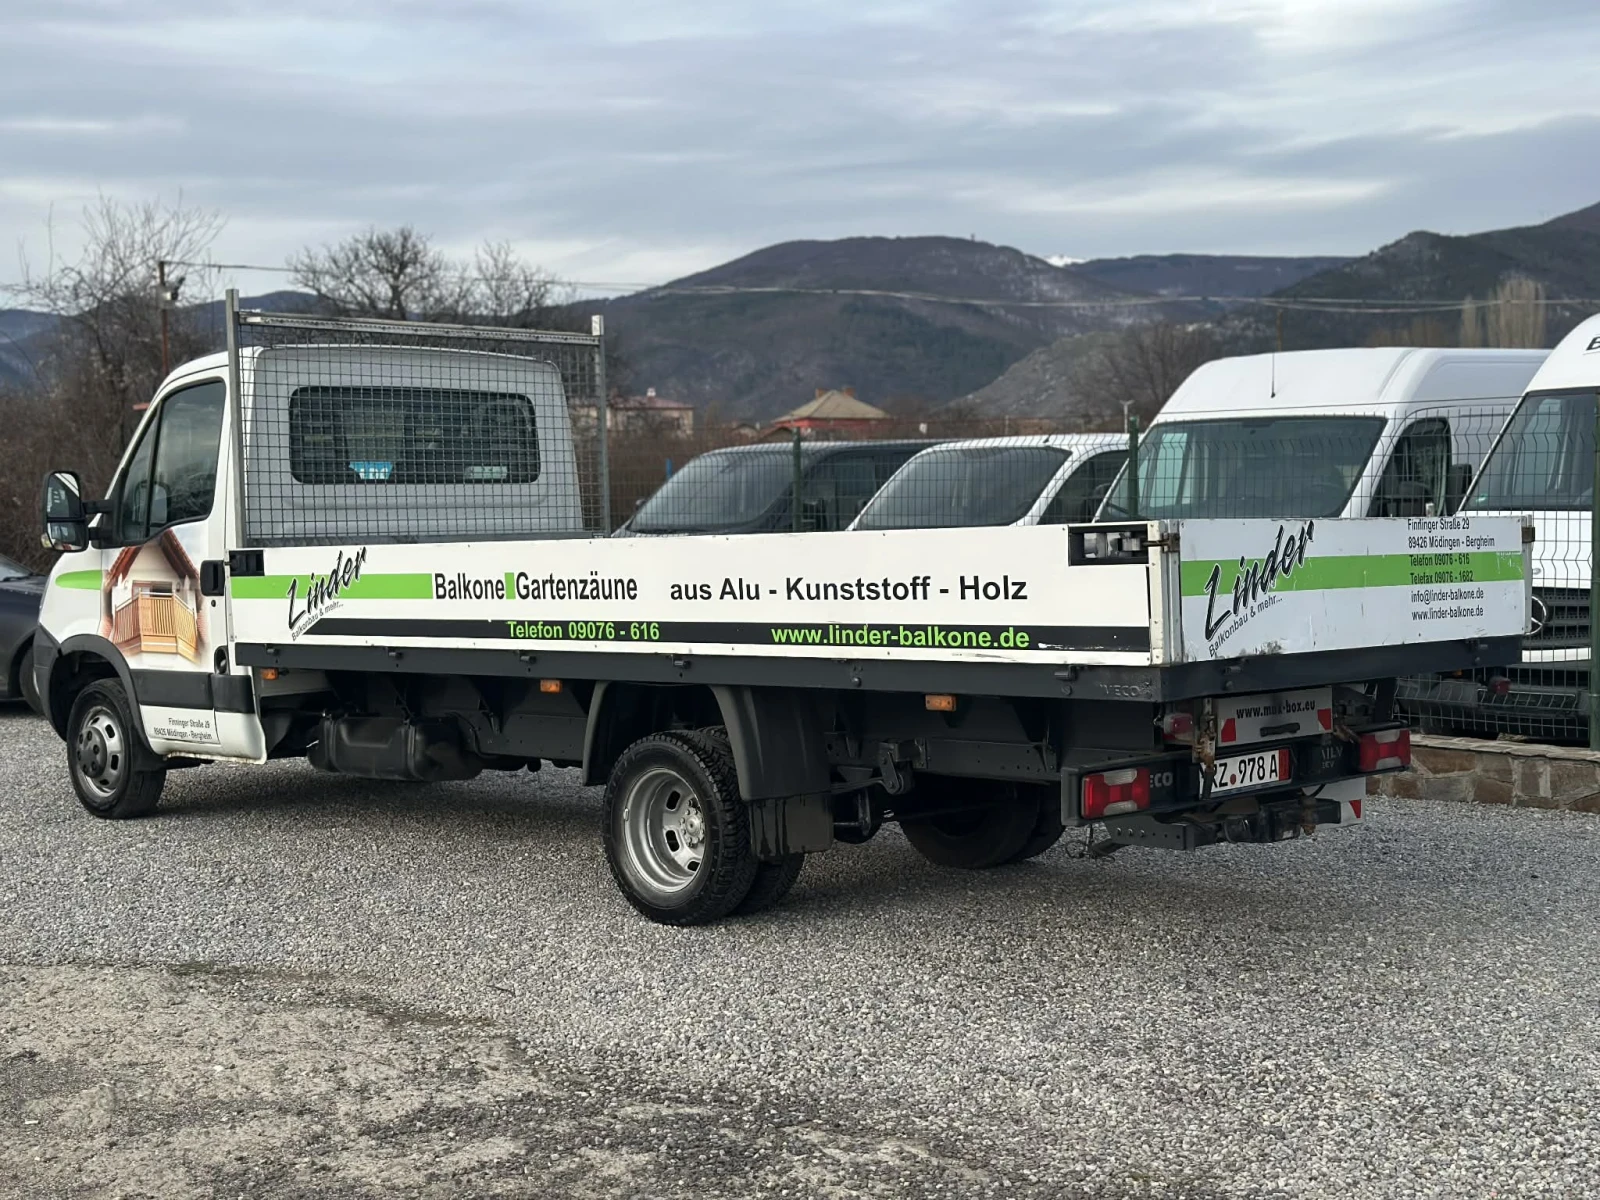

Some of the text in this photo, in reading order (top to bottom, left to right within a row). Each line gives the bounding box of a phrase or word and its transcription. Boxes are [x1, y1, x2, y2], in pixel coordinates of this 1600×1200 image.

[1408, 517, 1470, 533] Finninger Straße 29
[1408, 536, 1428, 549] 89426
[1429, 535, 1460, 550] Mödingen
[1466, 535, 1495, 549] Bergheim
[1409, 554, 1433, 567] Telefon
[1434, 553, 1453, 565] 09076
[1458, 553, 1470, 565] 616
[286, 546, 367, 630] Linder
[435, 571, 638, 600] Balkone Gartenzäune
[670, 582, 712, 600] aus
[719, 577, 760, 600] Alu
[786, 576, 931, 600] Kunststoff
[960, 575, 1027, 600] Holz
[1204, 520, 1315, 641] Linder
[1410, 572, 1433, 584] Telefax
[1434, 571, 1453, 583] 09076
[1458, 570, 1473, 582] 1682
[1411, 587, 1484, 605] info@linder-balkone.de
[1411, 605, 1484, 621] www.linder-balkone.de
[292, 612, 318, 642] Balkonbau
[507, 621, 563, 639] Telefon
[568, 622, 615, 639] 09076
[630, 622, 660, 640] 616
[771, 625, 1030, 648] www.linder-balkone.de
[1209, 612, 1248, 658] Balkonbau
[1250, 606, 1256, 618] &
[1238, 756, 1265, 784] 978
[1270, 754, 1278, 778] A
